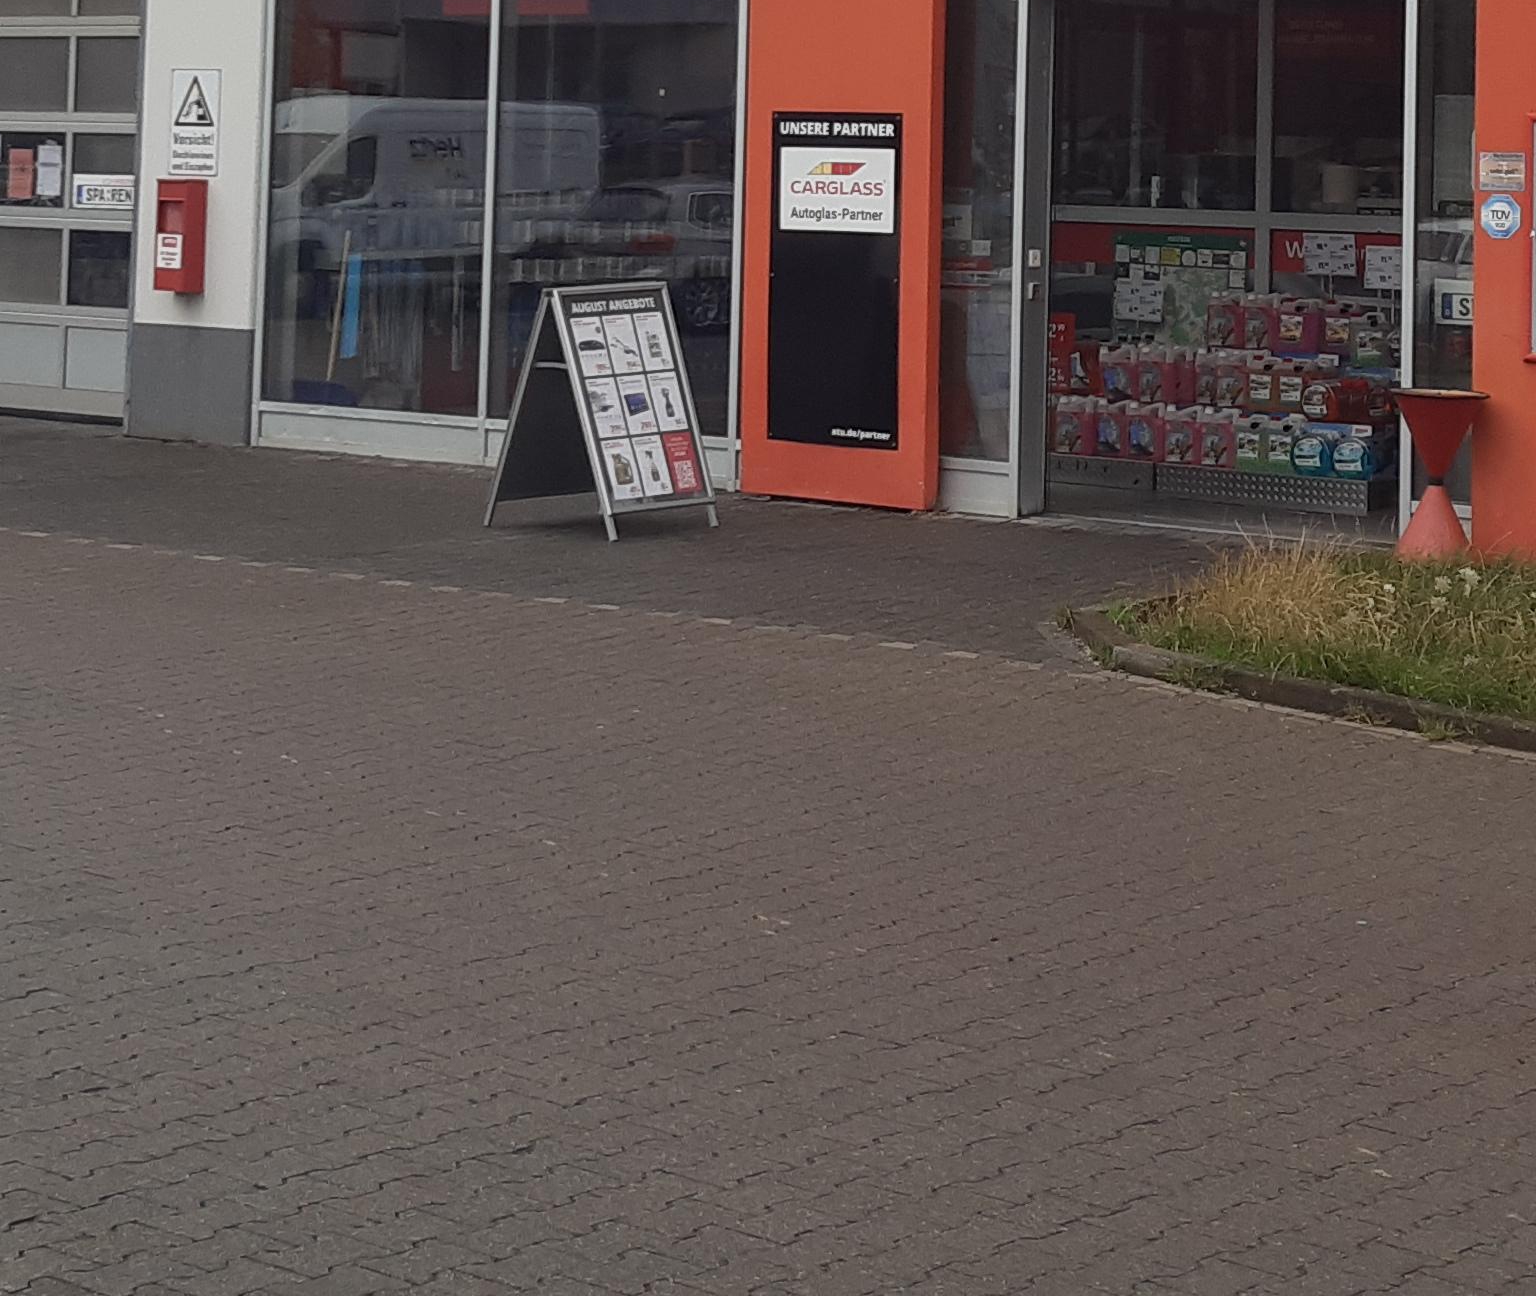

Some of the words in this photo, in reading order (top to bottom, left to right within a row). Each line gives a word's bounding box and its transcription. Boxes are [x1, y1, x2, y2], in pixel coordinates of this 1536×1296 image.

[780, 121, 830, 136] UNSERE
[833, 122, 895, 137] PARTNER
[790, 180, 884, 196] CARGLASS
[790, 206, 883, 222] Autoglas-Partner
[571, 300, 607, 313] AUGUST
